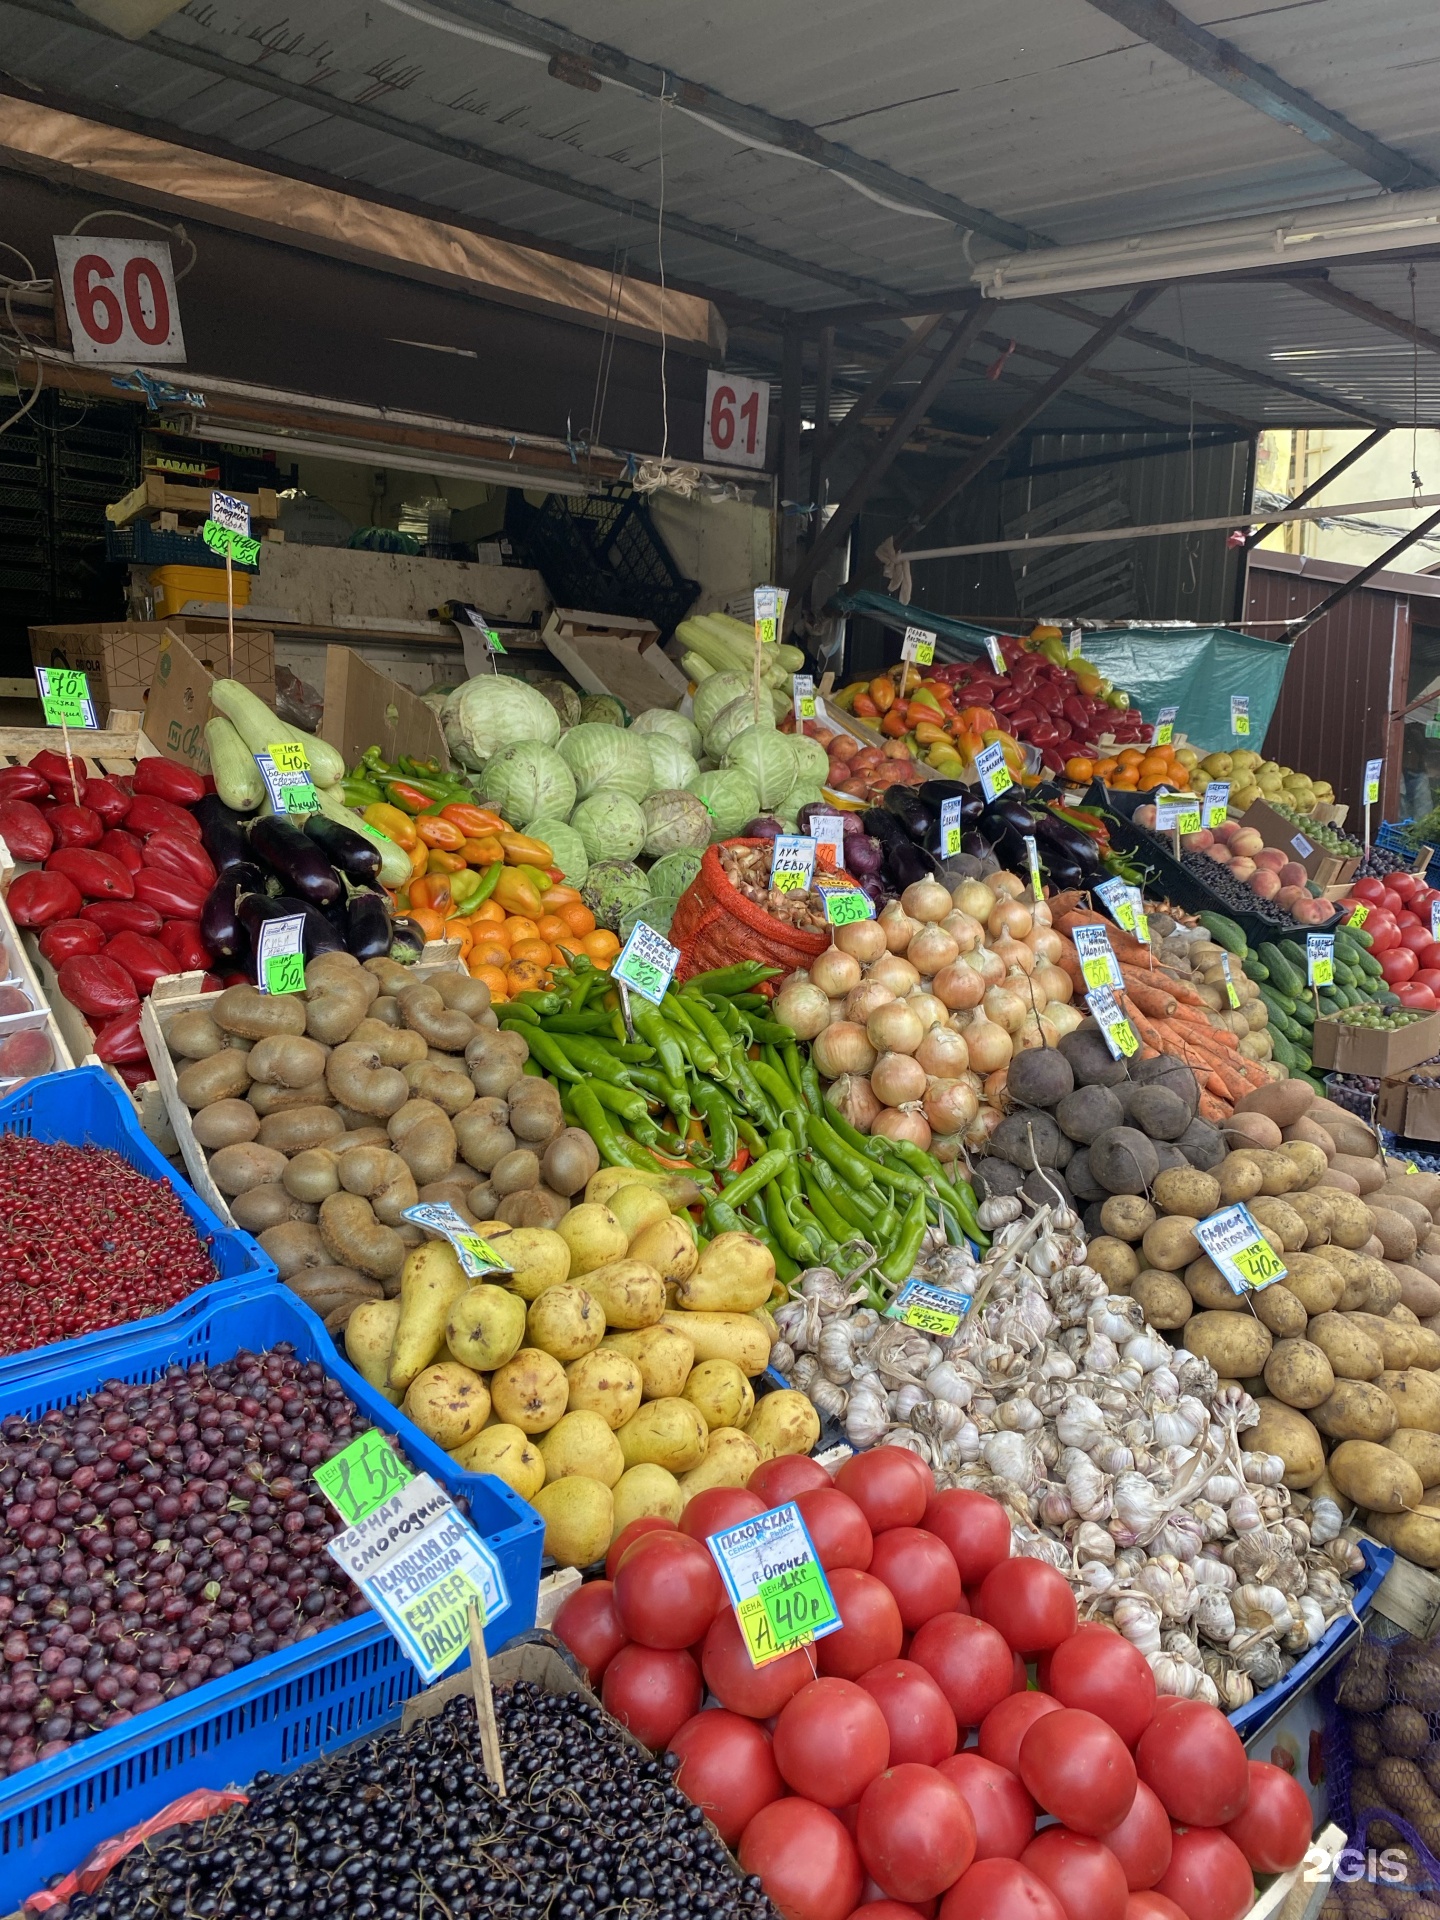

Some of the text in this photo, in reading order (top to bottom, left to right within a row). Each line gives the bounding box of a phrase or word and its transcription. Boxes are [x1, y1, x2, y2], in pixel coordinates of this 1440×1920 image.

[73, 254, 169, 346] 60
[711, 386, 759, 454] 61
[283, 754, 310, 770] 40р
[779, 848, 799, 857] ЛУК
[775, 858, 811, 877] СЕВОК
[833, 901, 863, 924] 35р
[1091, 966, 1110, 985] 50р
[1248, 1255, 1279, 1279] 40р
[917, 1319, 950, 1333] 50р
[721, 1507, 794, 1551] ПСКОВСКАЯ
[728, 1522, 796, 1557] СЕННОЙ РЫНОК
[761, 1582, 782, 1598] ЦЕНА
[405, 1573, 465, 1633] СУПЕР
[740, 1600, 762, 1615] ЦЕНА
[775, 1590, 820, 1630] 40р
